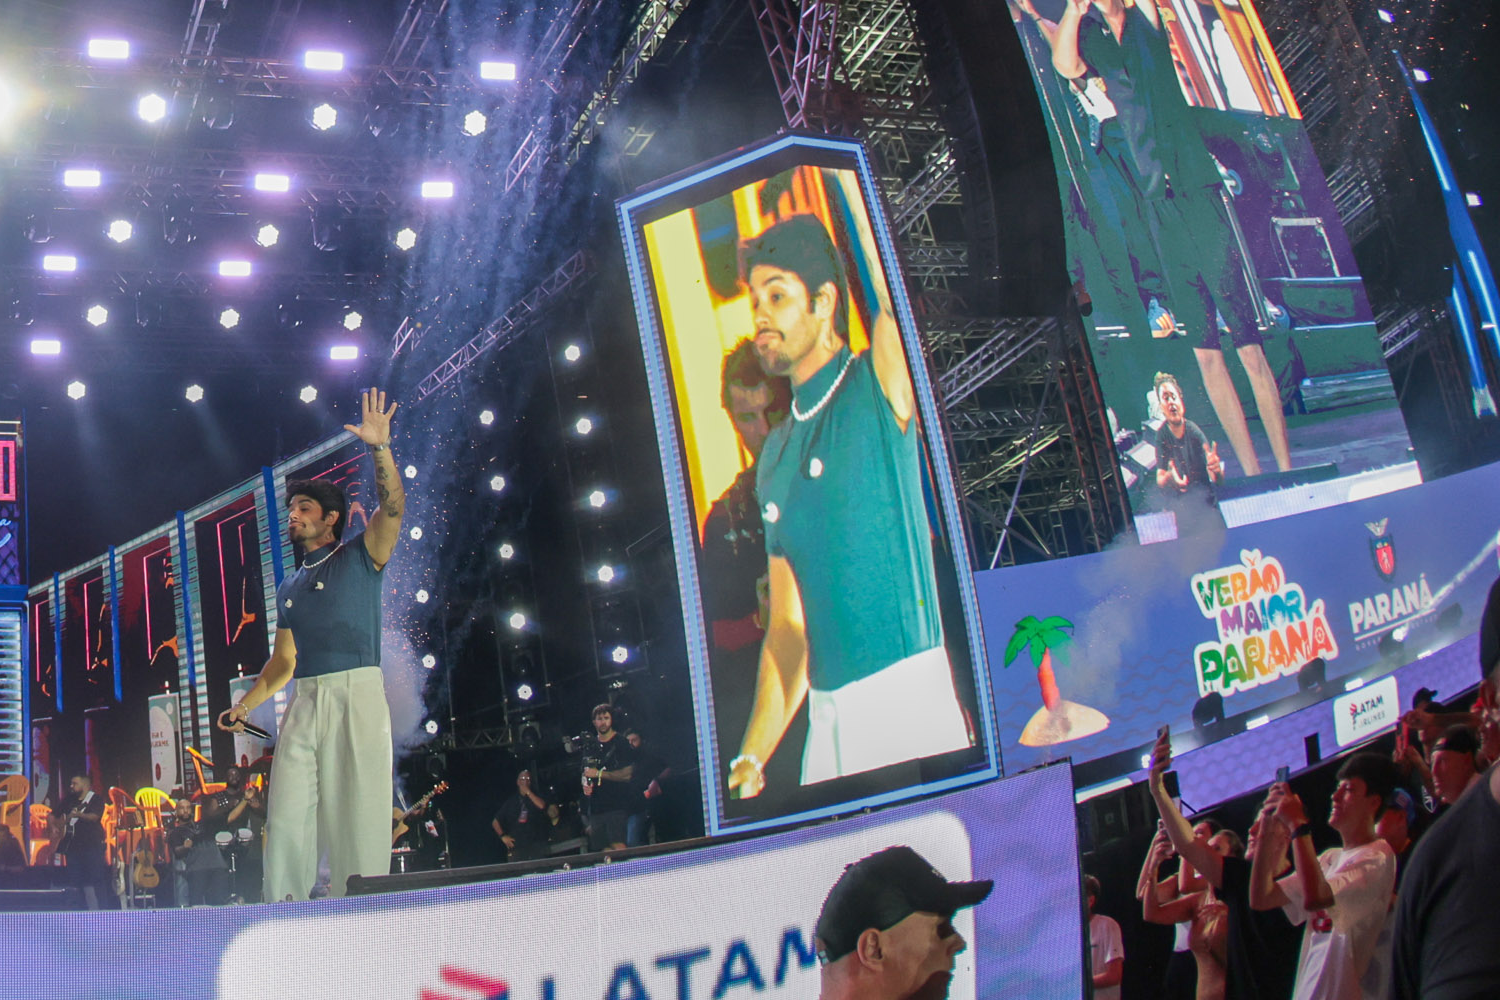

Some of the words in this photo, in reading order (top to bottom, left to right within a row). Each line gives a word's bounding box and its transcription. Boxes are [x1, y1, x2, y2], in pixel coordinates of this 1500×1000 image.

[1197, 556, 1280, 612] VERÃO
[1220, 589, 1304, 637] MAIOR
[1348, 572, 1434, 634] PARANÁ
[1199, 605, 1334, 692] PARANÁ
